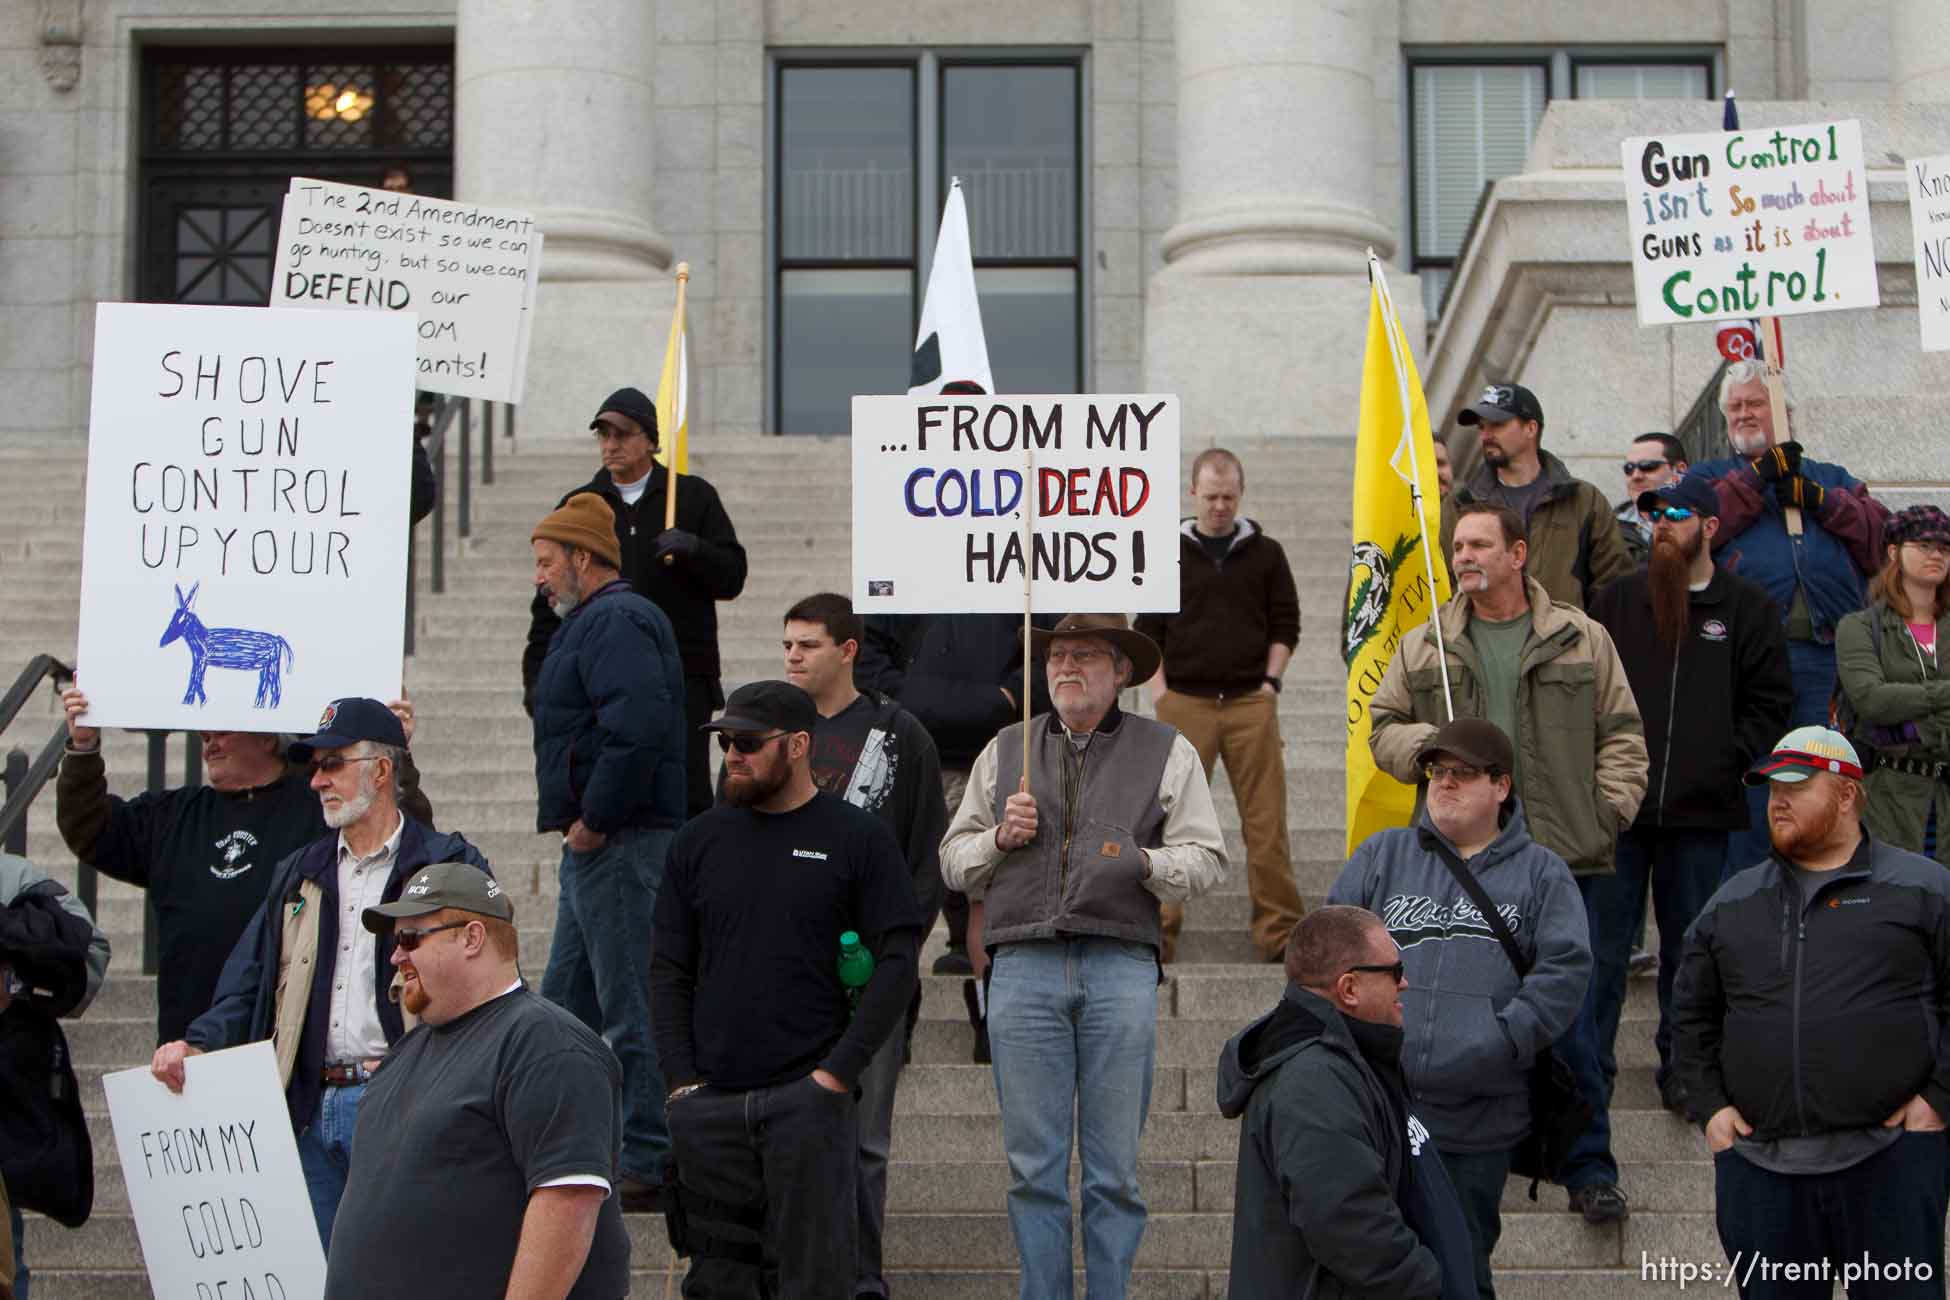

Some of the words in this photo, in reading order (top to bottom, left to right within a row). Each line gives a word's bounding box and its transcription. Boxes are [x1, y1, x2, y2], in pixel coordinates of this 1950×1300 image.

[1641, 140, 1711, 188] Gun
[1726, 125, 1838, 169] Control
[301, 186, 346, 209] The
[355, 192, 400, 216] 2nd
[406, 200, 533, 235] Amendment
[1642, 181, 1713, 225] isn't
[1761, 180, 1805, 211] much
[1809, 169, 1856, 207] about
[290, 242, 312, 268] go
[399, 253, 429, 269] but
[437, 259, 460, 273] so
[465, 261, 496, 276] we
[496, 265, 528, 281] can
[297, 218, 370, 239] Doesn't
[374, 224, 432, 243] exist
[439, 234, 466, 249] so
[467, 236, 492, 249] we
[499, 239, 528, 254] can
[1642, 232, 1702, 261] GUNS
[1714, 235, 1733, 252] as
[1745, 219, 1766, 252] it
[1775, 226, 1792, 248] is
[1803, 211, 1855, 242] about
[284, 271, 410, 311] DEFEND
[431, 289, 470, 306] our
[1662, 247, 1841, 318] Control.
[158, 350, 334, 403] SHOVE
[201, 416, 299, 457] GUN
[1086, 401, 1167, 451] MY
[133, 462, 360, 518] CONTROL
[904, 467, 1024, 520] COLD,
[1038, 467, 1151, 517] DEAD
[142, 523, 200, 569] UP
[214, 528, 351, 579] YOUR
[966, 530, 1146, 586] HANDS!
[141, 1127, 214, 1179] FROM
[218, 1119, 260, 1175] MY
[182, 1197, 263, 1259] COLD
